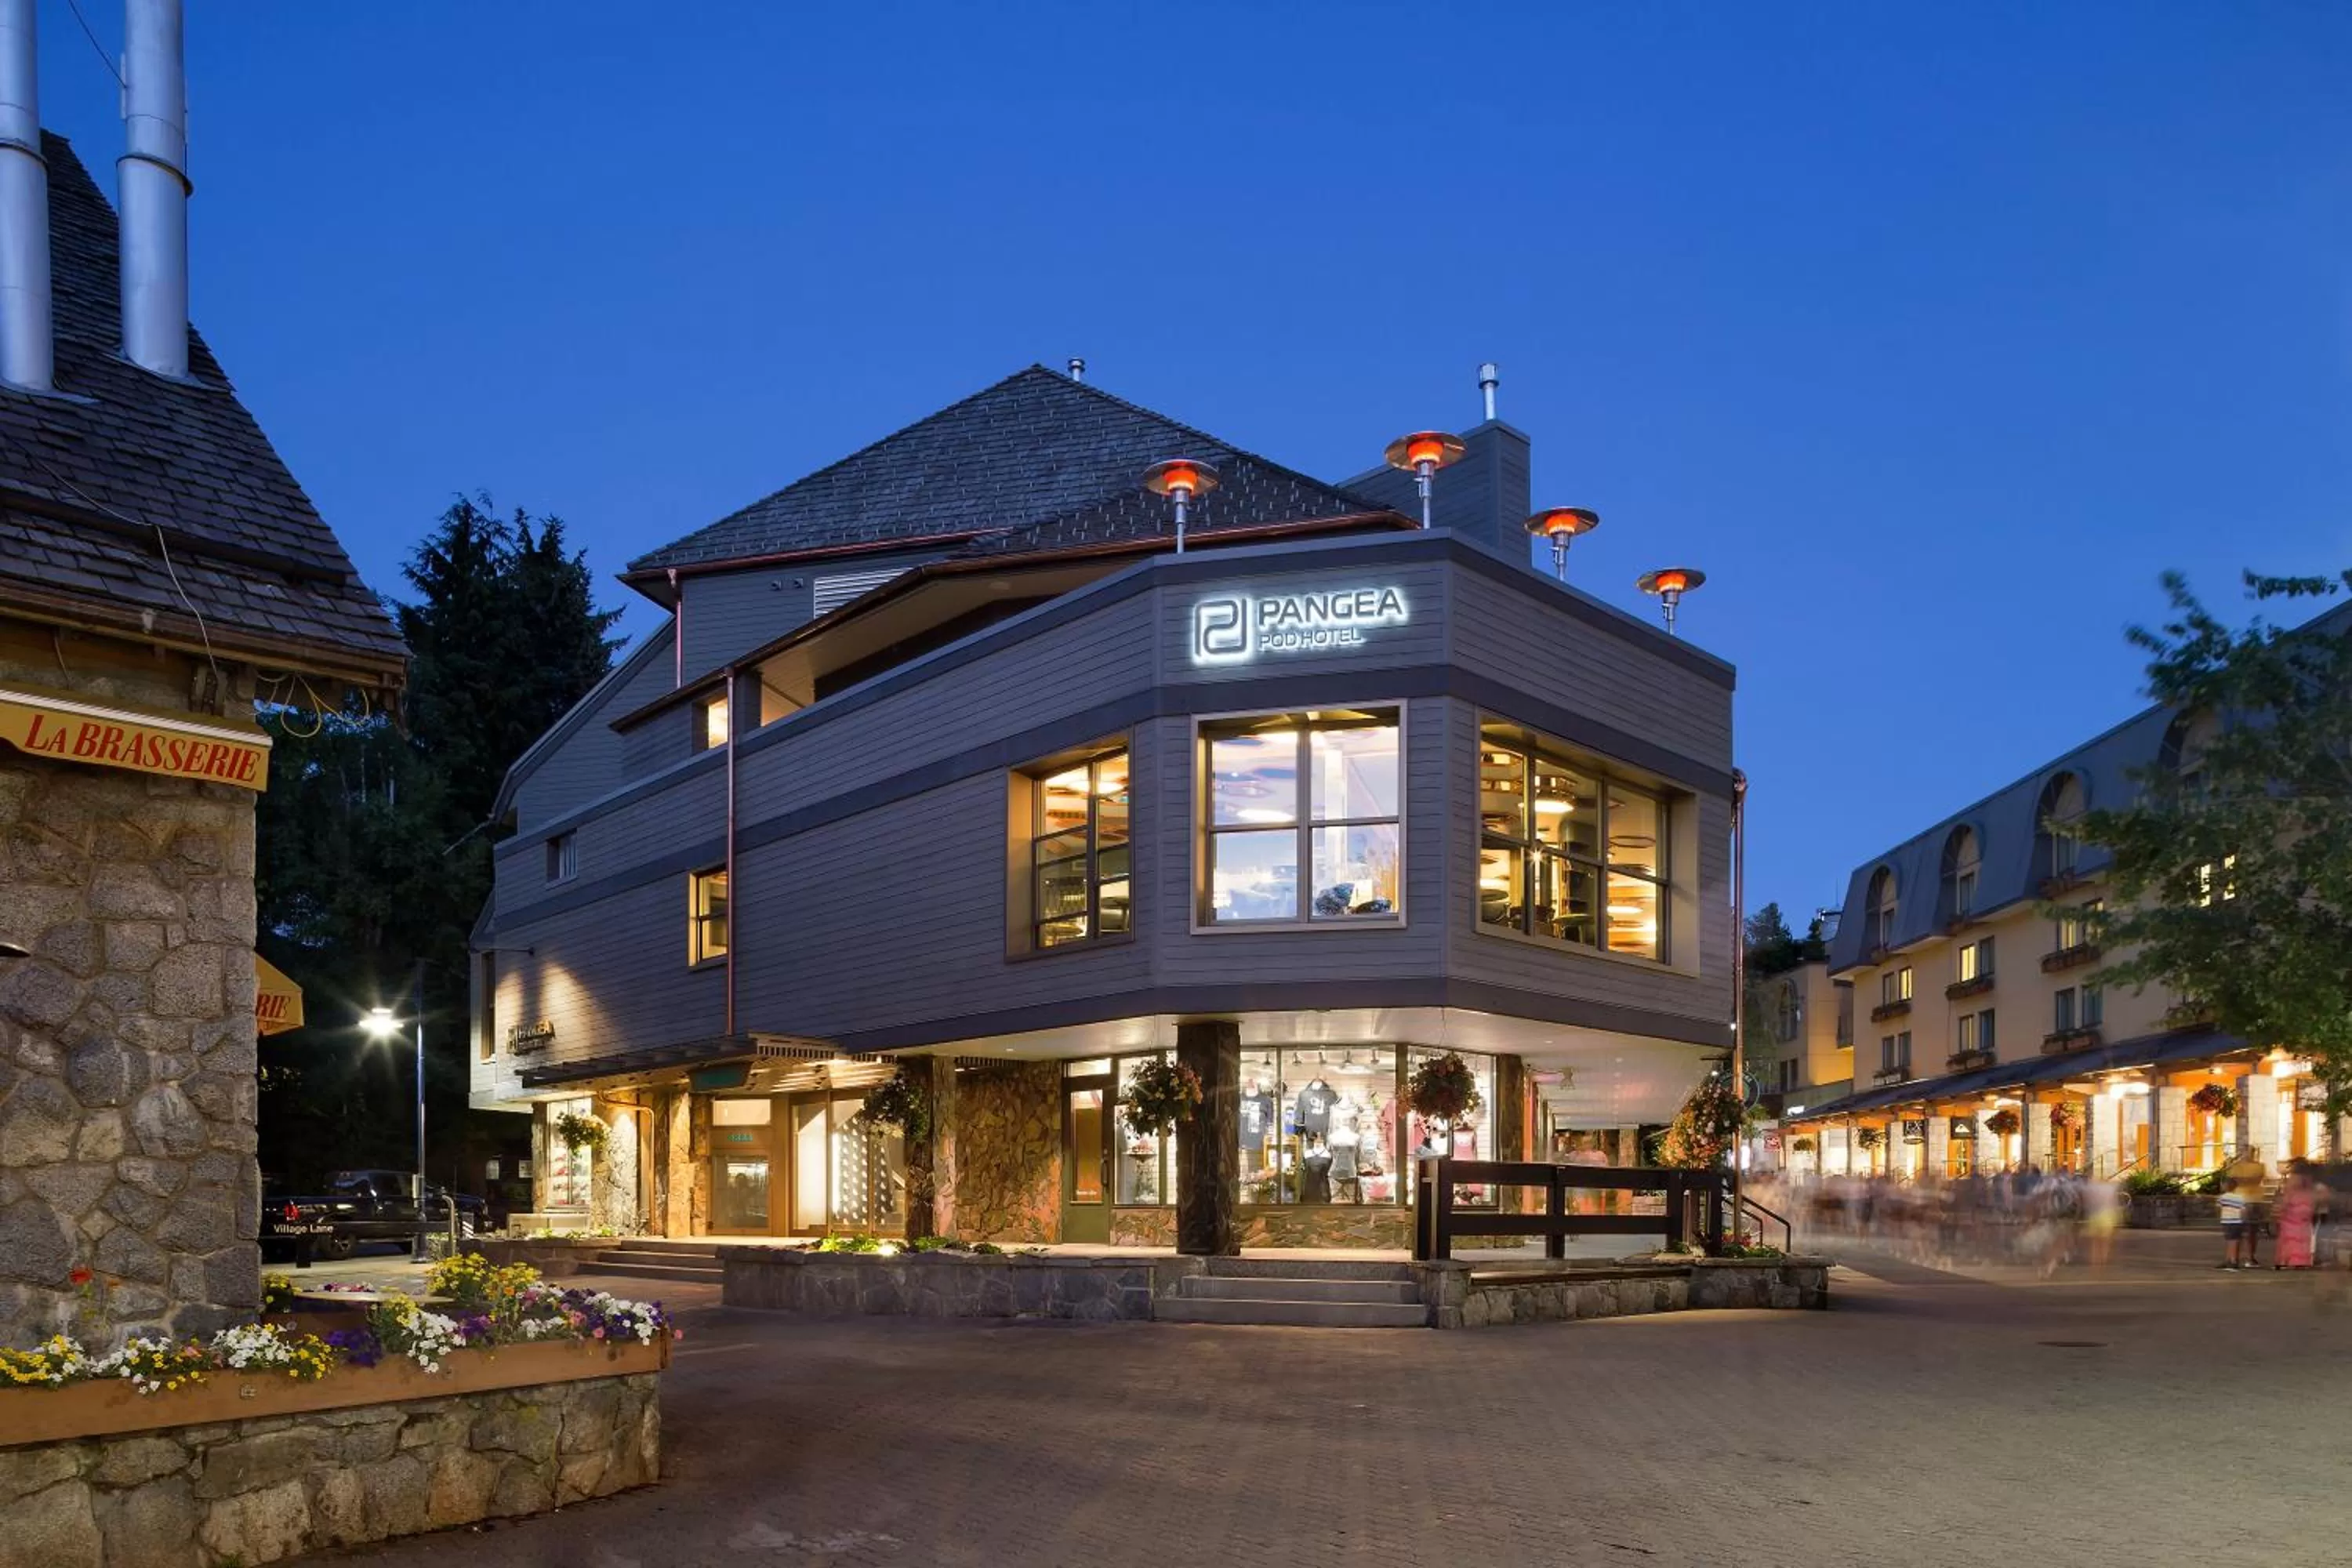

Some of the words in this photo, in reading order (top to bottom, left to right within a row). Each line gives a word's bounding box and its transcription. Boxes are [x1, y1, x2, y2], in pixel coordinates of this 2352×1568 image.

[1258, 590, 1403, 626] PANGEA
[1260, 633, 1297, 648] POD
[1301, 627, 1362, 645] HOTEL
[72, 721, 260, 782] BRASSERIE
[273, 1224, 307, 1235] Village
[310, 1224, 333, 1234] Lane
